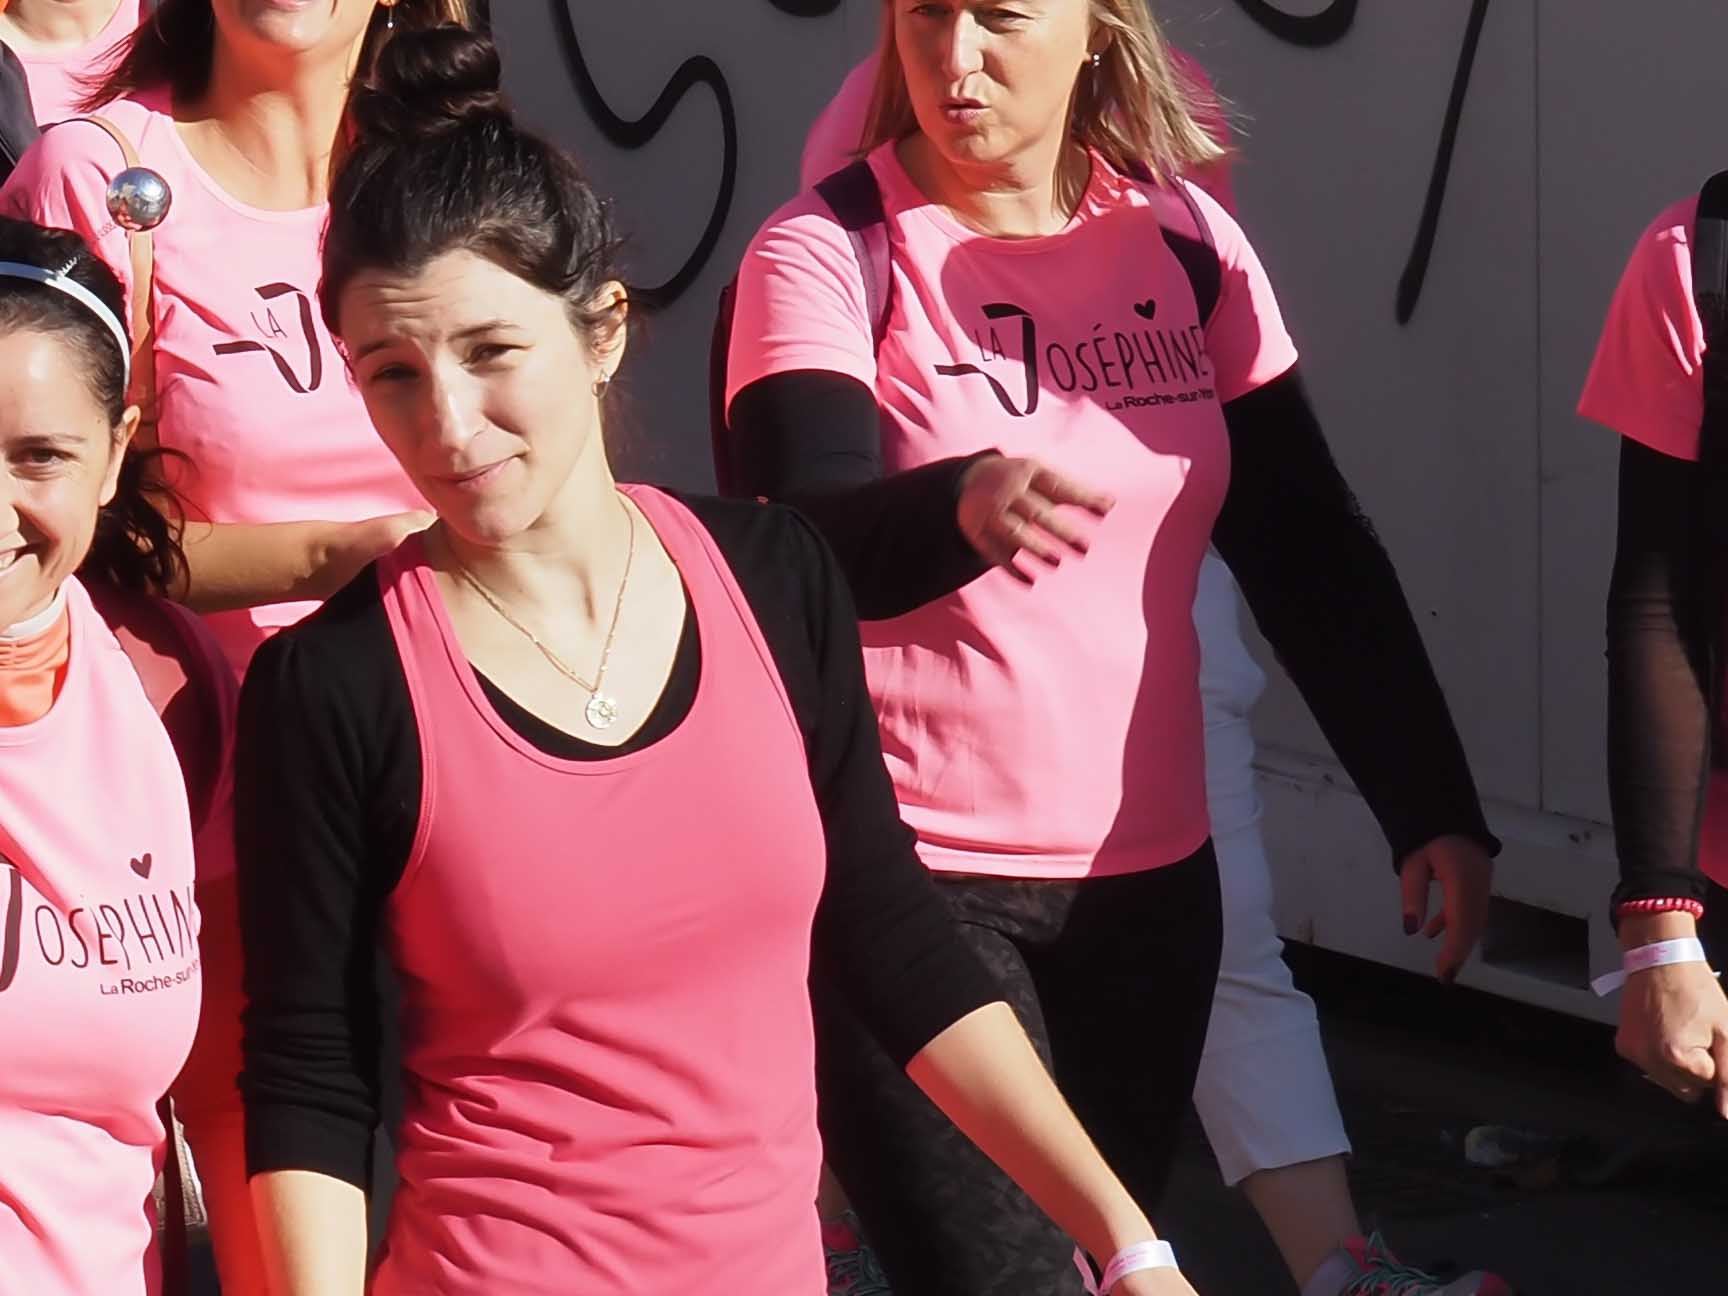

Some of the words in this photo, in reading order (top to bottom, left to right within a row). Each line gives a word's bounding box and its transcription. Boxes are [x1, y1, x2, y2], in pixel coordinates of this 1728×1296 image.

[249, 307, 289, 339] LA
[974, 326, 1008, 363] LA
[976, 302, 1210, 418] JOSÉPHINE
[99, 982, 119, 996] La
